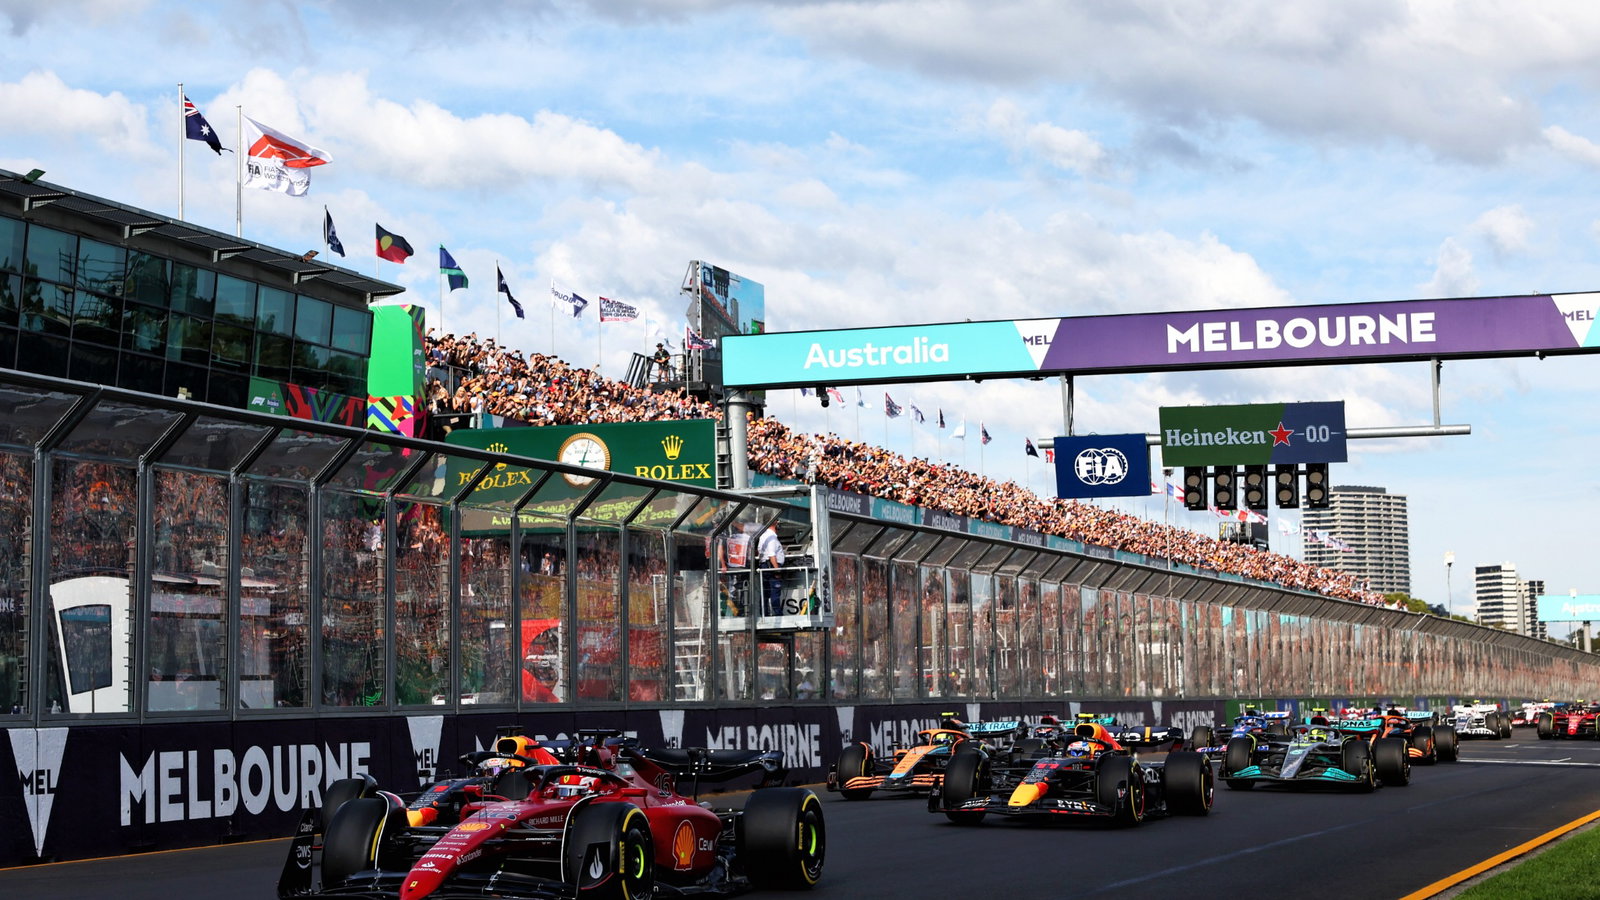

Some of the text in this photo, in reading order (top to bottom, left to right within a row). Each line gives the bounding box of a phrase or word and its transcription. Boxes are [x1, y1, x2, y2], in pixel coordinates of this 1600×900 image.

[1562, 310, 1594, 321] MEL
[1023, 335, 1050, 345] MEL
[1167, 312, 1437, 353] MELBOURNE
[804, 337, 949, 369] Australia
[1165, 427, 1266, 447] Heineken
[635, 463, 711, 481] ROLEX
[414, 748, 437, 769] MEL
[20, 769, 57, 795] MEL
[655, 772, 672, 797] 16
[529, 815, 563, 826] RICHARD MILLE
